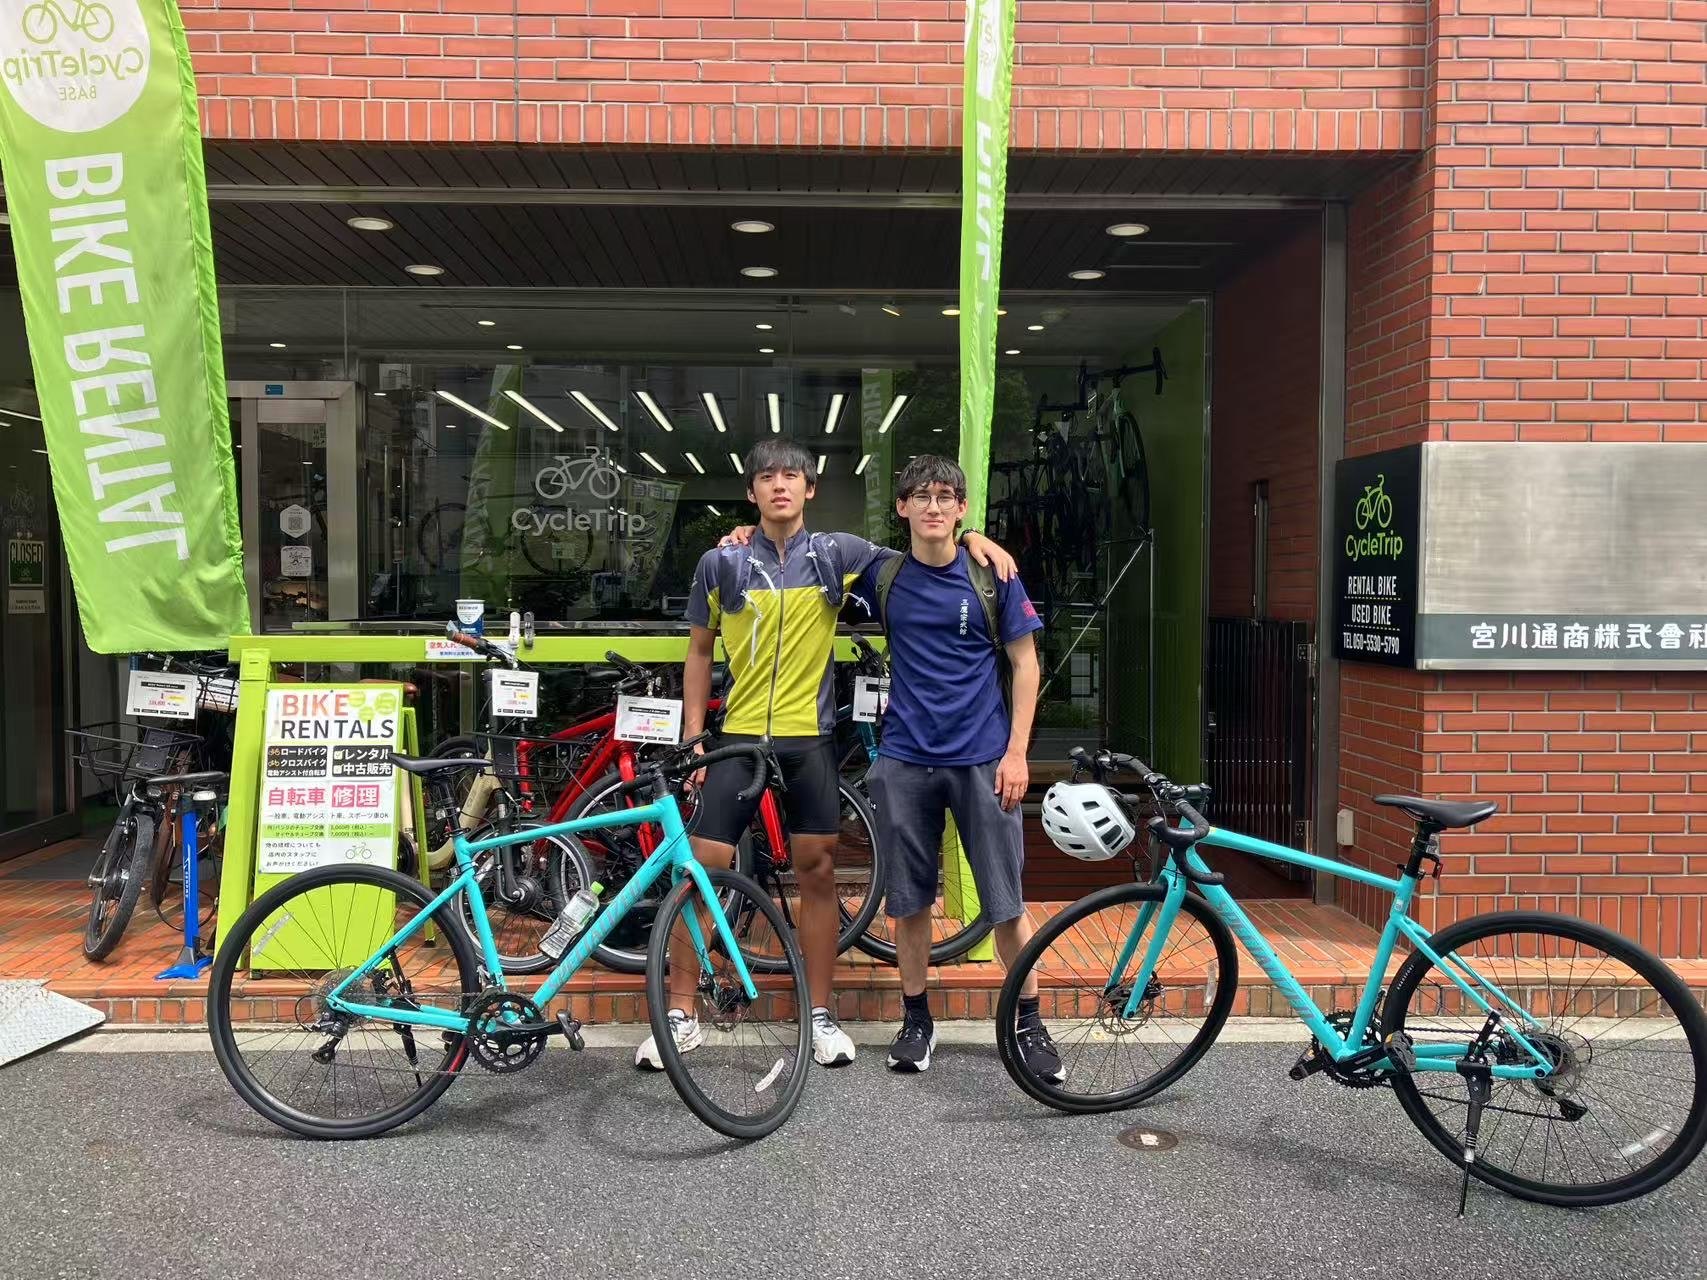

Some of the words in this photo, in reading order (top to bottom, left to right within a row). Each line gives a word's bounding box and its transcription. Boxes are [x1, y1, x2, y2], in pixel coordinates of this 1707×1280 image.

[512, 507, 646, 537] CycleTrip
[10, 542, 43, 563] CLOSED
[1346, 530, 1403, 561] CycleTrip
[1348, 576, 1376, 595] RENTAL
[1378, 576, 1397, 596] BIKE
[1351, 604, 1371, 623] USED
[1373, 605, 1392, 625] BIKE
[282, 694, 349, 716] BIKE
[280, 718, 394, 739] RENTALS
[281, 747, 327, 756] ロードバイク
[281, 758, 327, 767] クロスバイク
[343, 762, 392, 775] 中古販売
[268, 787, 326, 806] 自転車
[332, 785, 380, 807] 修理
